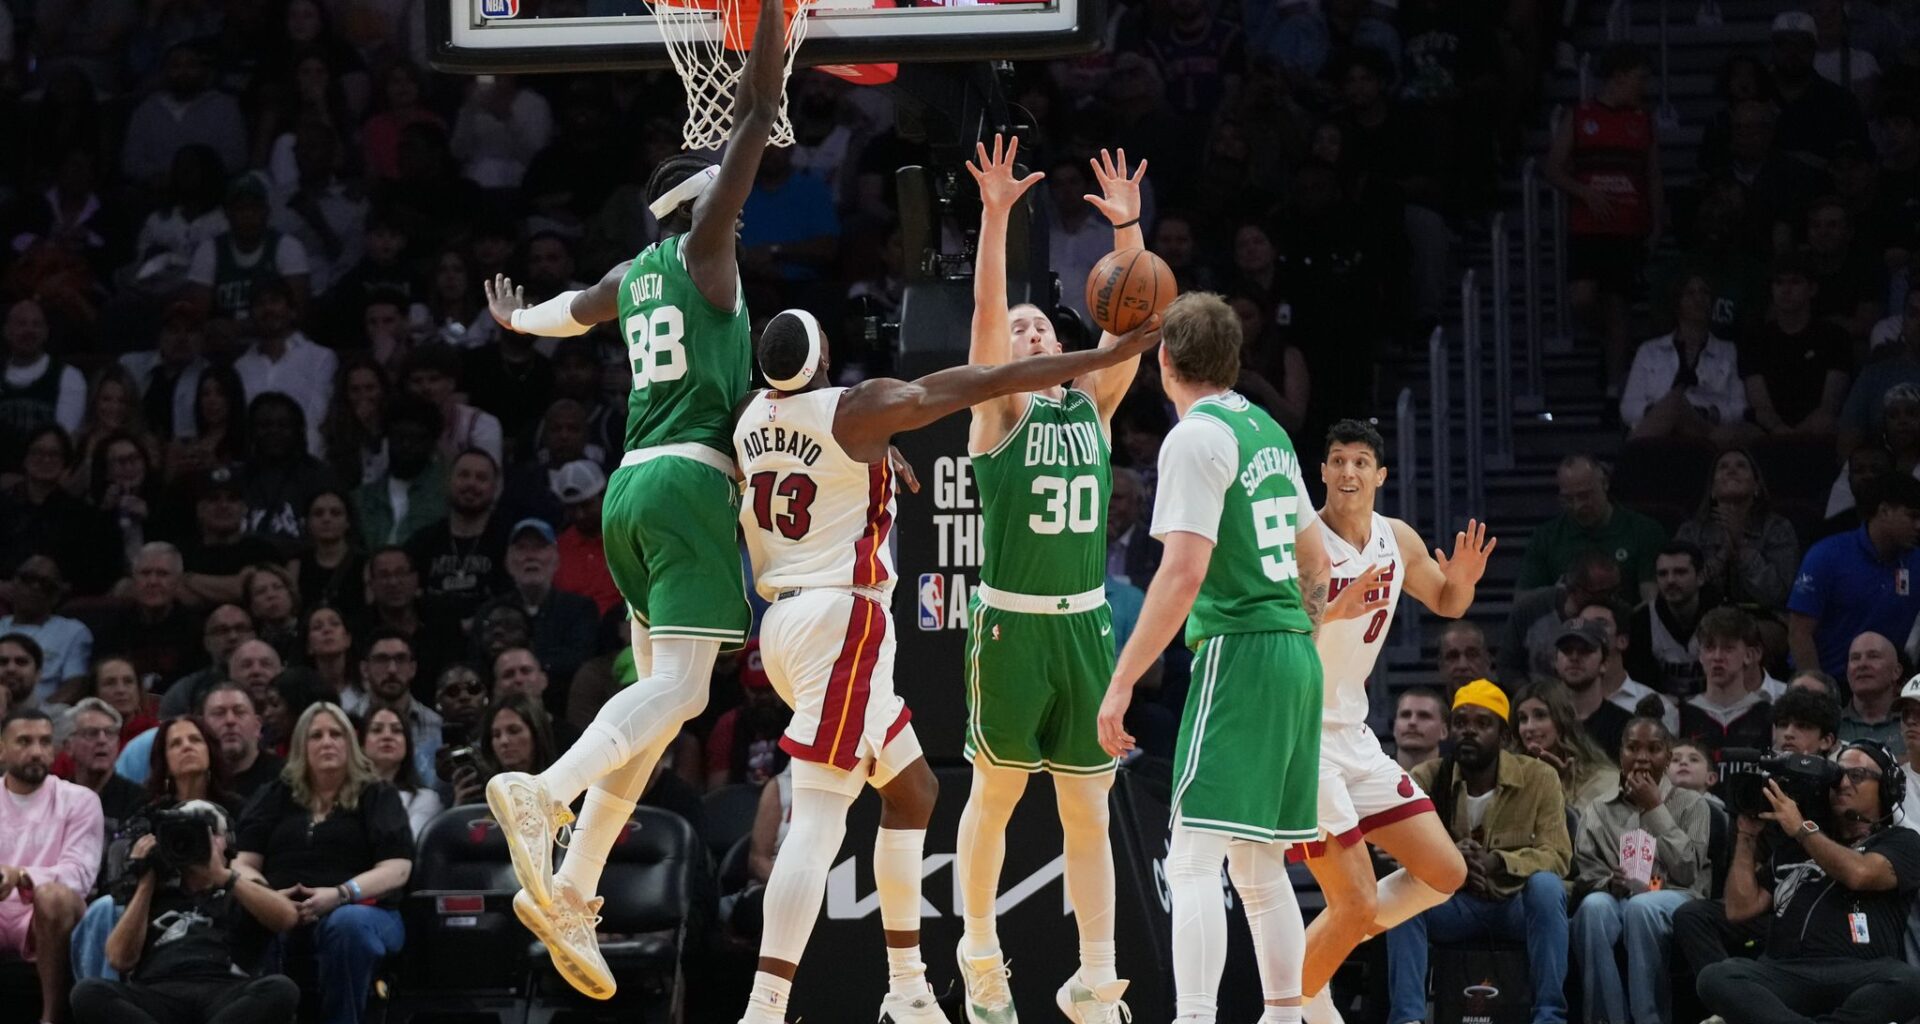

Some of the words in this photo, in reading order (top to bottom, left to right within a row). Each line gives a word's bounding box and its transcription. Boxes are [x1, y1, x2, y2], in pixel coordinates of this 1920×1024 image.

[629, 273, 663, 306] QUETA
[1096, 266, 1124, 322] Wilson
[625, 304, 688, 391] 88
[743, 427, 822, 467] ADEBAYO
[1024, 422, 1100, 467] BOSTON
[933, 455, 983, 510] GE
[1240, 446, 1299, 497] SCHEIERMA
[749, 470, 818, 541] 13
[1028, 474, 1100, 535] 30
[1250, 495, 1299, 582] 55
[1327, 559, 1396, 603] HAT
[1363, 609, 1388, 644] 0
[1461, 1015, 1492, 1024] MIAMI
